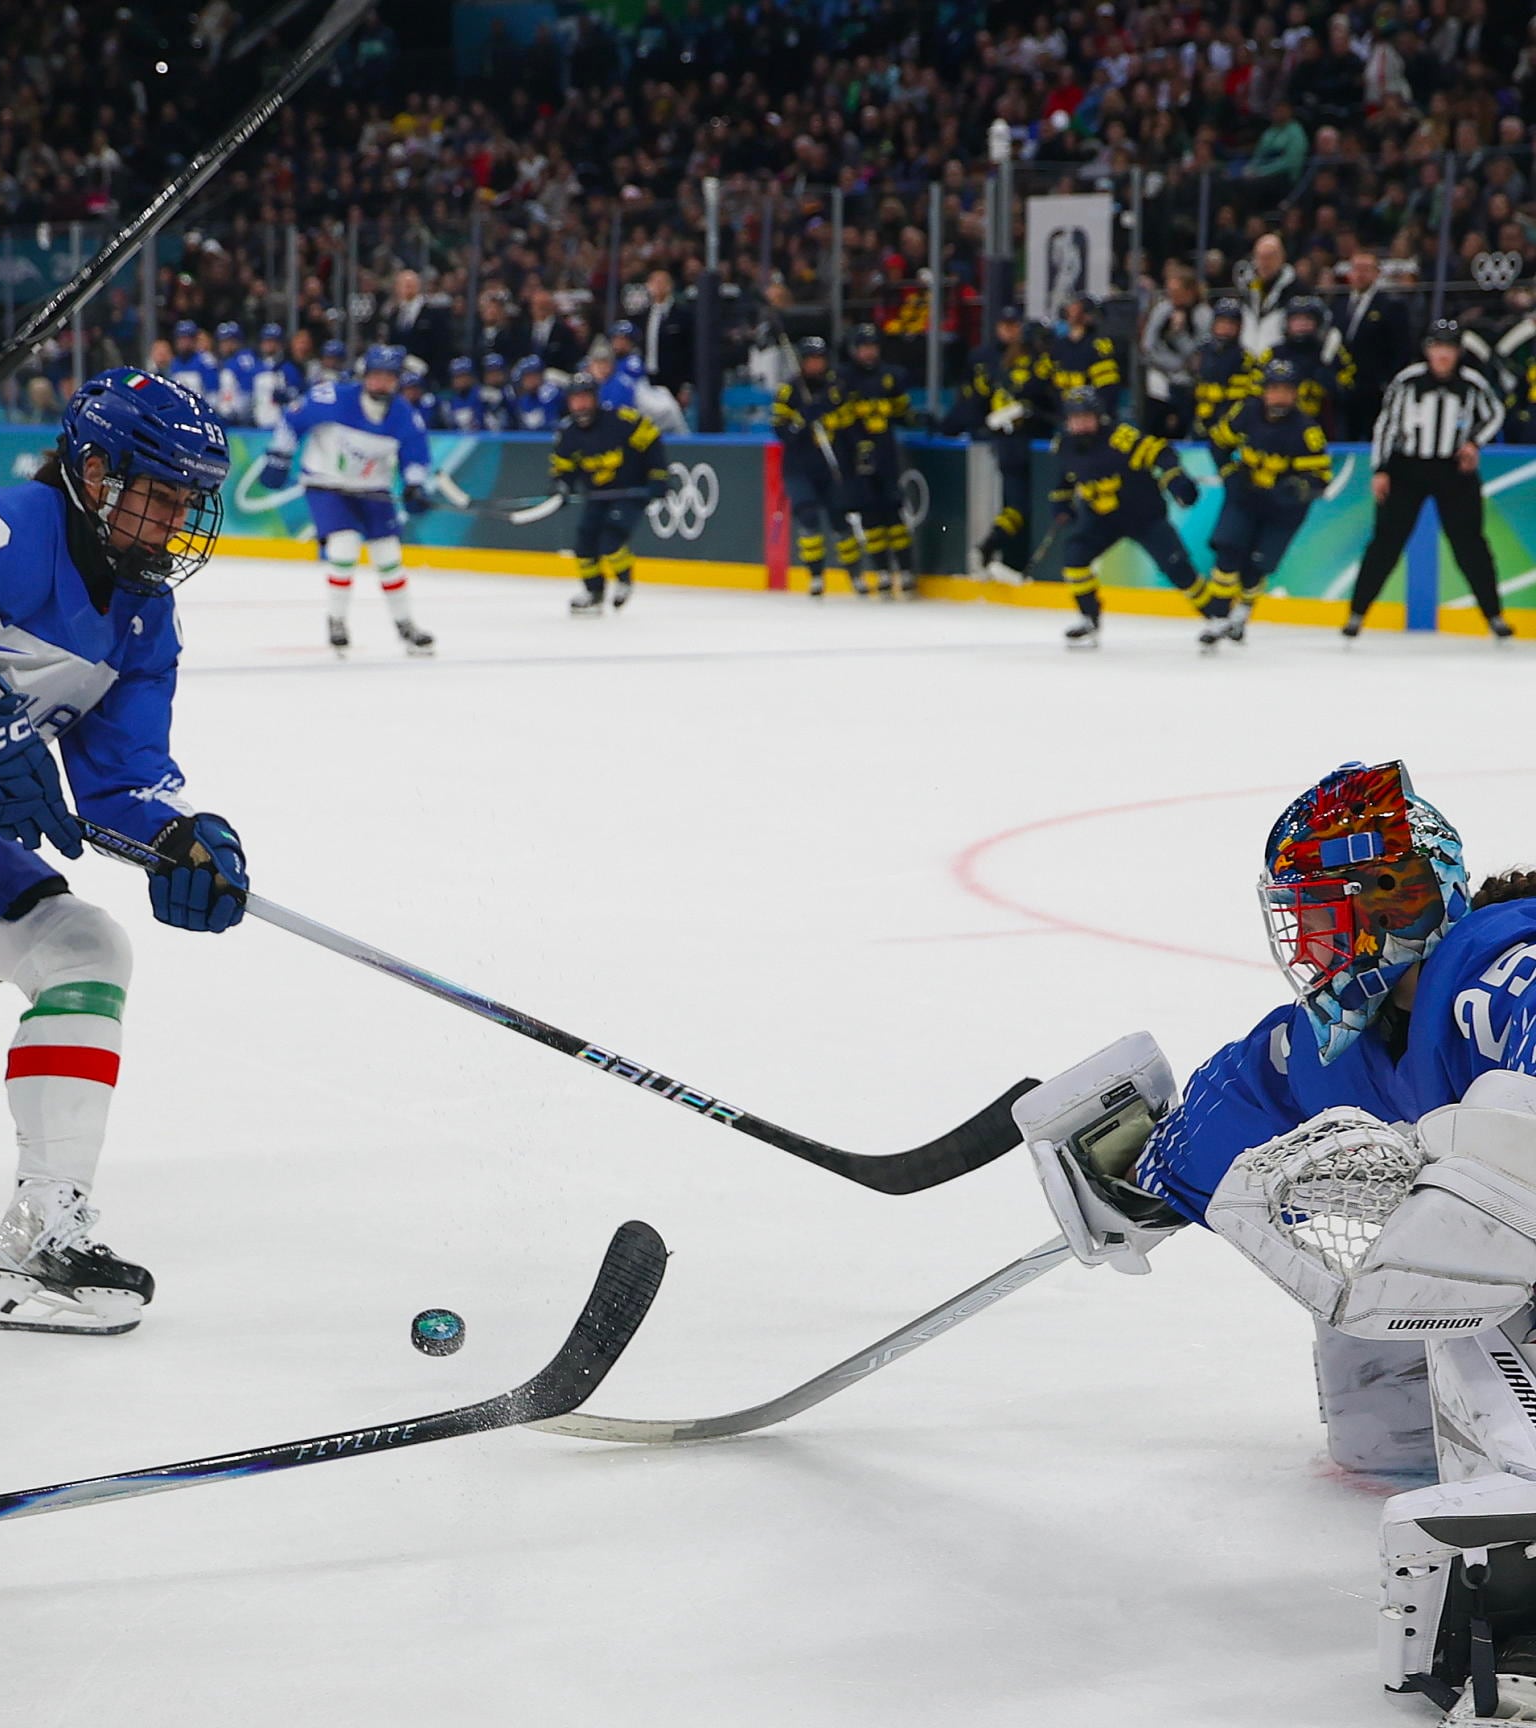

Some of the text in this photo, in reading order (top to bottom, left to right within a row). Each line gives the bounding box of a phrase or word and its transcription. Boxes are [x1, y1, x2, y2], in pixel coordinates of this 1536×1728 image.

[84, 409, 113, 431] CCM
[204, 422, 226, 447] 93
[95, 831, 161, 867] BAUER
[1454, 942, 1536, 1063] 25
[575, 1042, 746, 1128] BAUER
[1386, 1316, 1485, 1331] WARRIOR
[294, 1423, 419, 1462] FLYLITE
